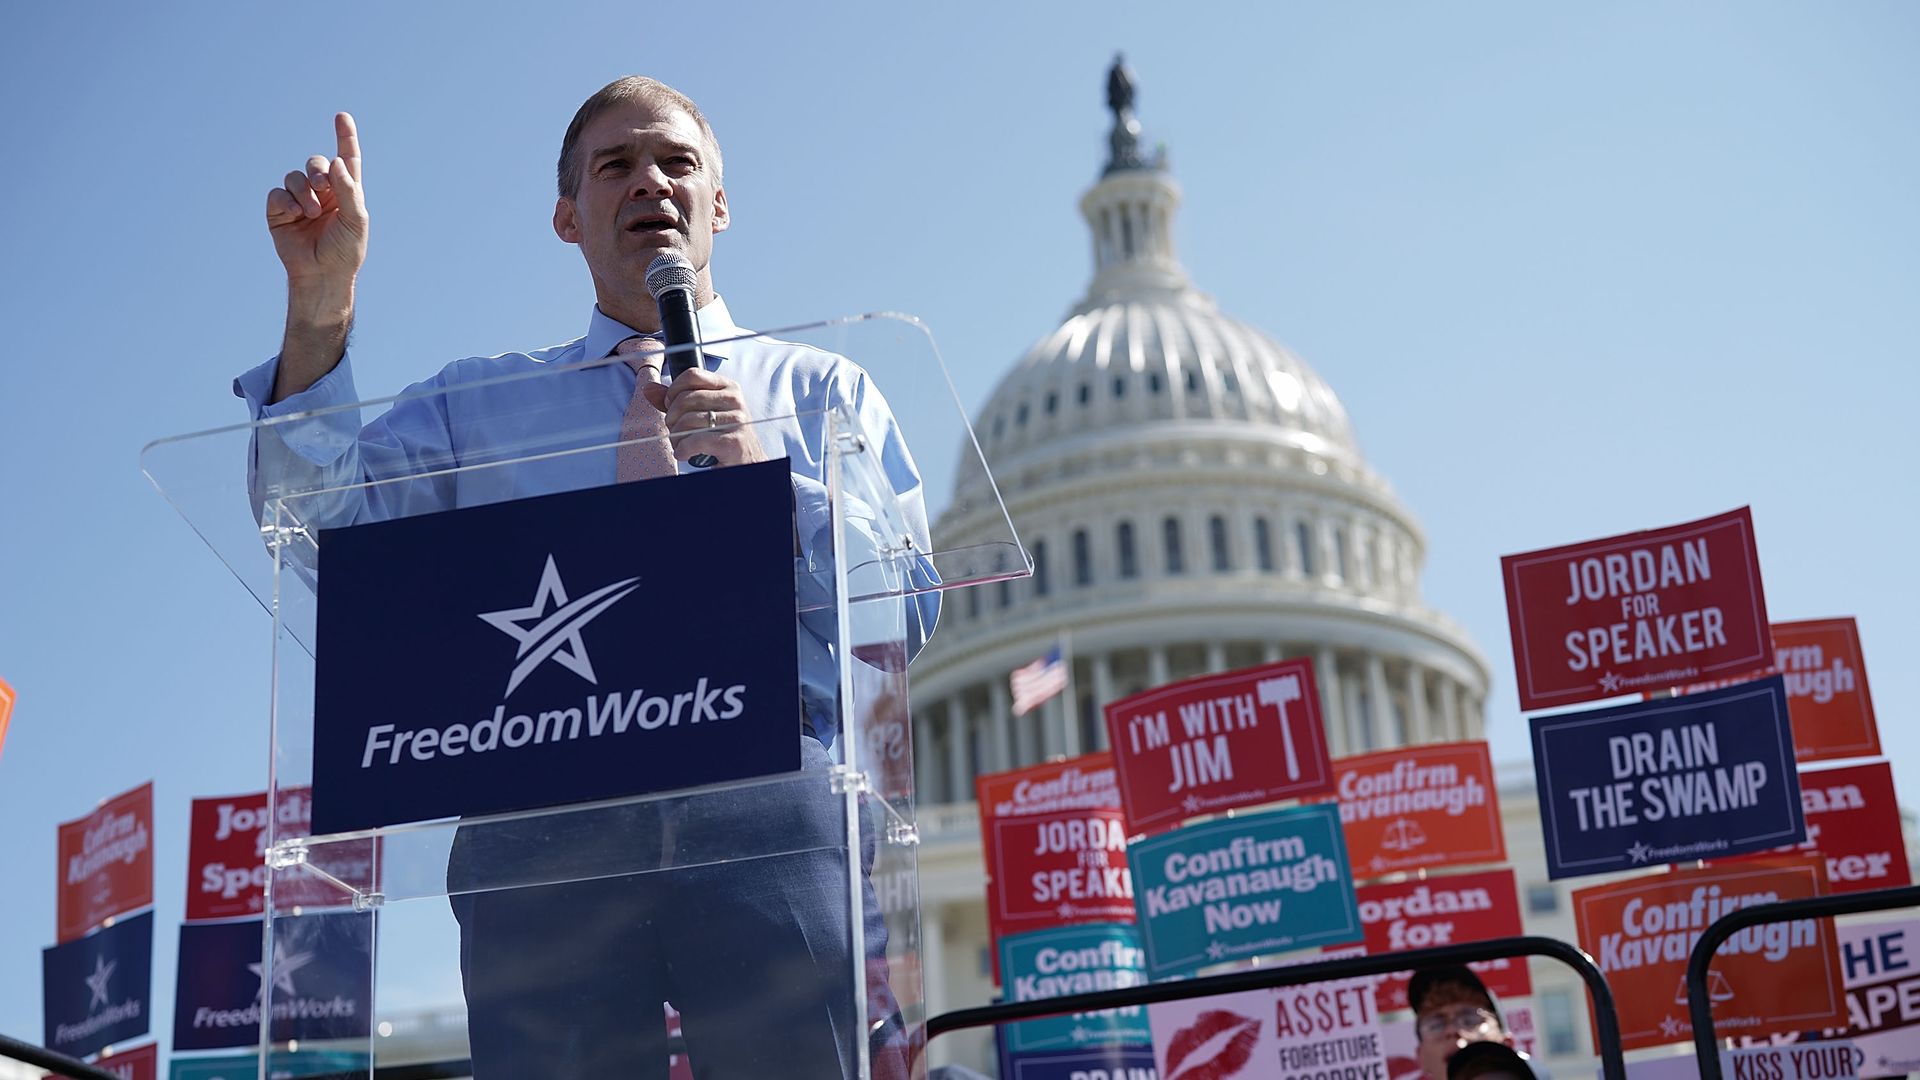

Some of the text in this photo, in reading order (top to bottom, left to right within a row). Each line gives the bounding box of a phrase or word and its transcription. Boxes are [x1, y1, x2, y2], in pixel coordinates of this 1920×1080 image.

[1566, 538, 1711, 605] JORDAN
[1622, 594, 1660, 621] FOR
[1565, 607, 1727, 672] SPEAKER
[362, 678, 746, 767] FreedomWorks
[1129, 693, 1258, 754] I'M WITH
[1168, 735, 1234, 793] JIM
[1609, 722, 1719, 780] DRAIN
[1339, 758, 1458, 801] Confirm
[1340, 775, 1486, 823] avanaugh
[1569, 782, 1638, 831] THE
[1641, 761, 1768, 822] SWAMP
[1034, 817, 1126, 856] JORDA
[1077, 850, 1109, 869] FOR
[1164, 836, 1306, 882] Confirm
[1032, 867, 1134, 903] SPEAK
[1146, 854, 1338, 918] Kavanaugh
[1360, 886, 1492, 923] ordan
[1203, 899, 1282, 935] Now
[1388, 920, 1454, 950] for
[1843, 930, 1909, 978] HE
[193, 996, 356, 1028] FreedmWorks
[1846, 977, 1920, 1030] APE
[1279, 1033, 1381, 1071] FORFEITURE
[1734, 1046, 1854, 1080] KISS YOUR
